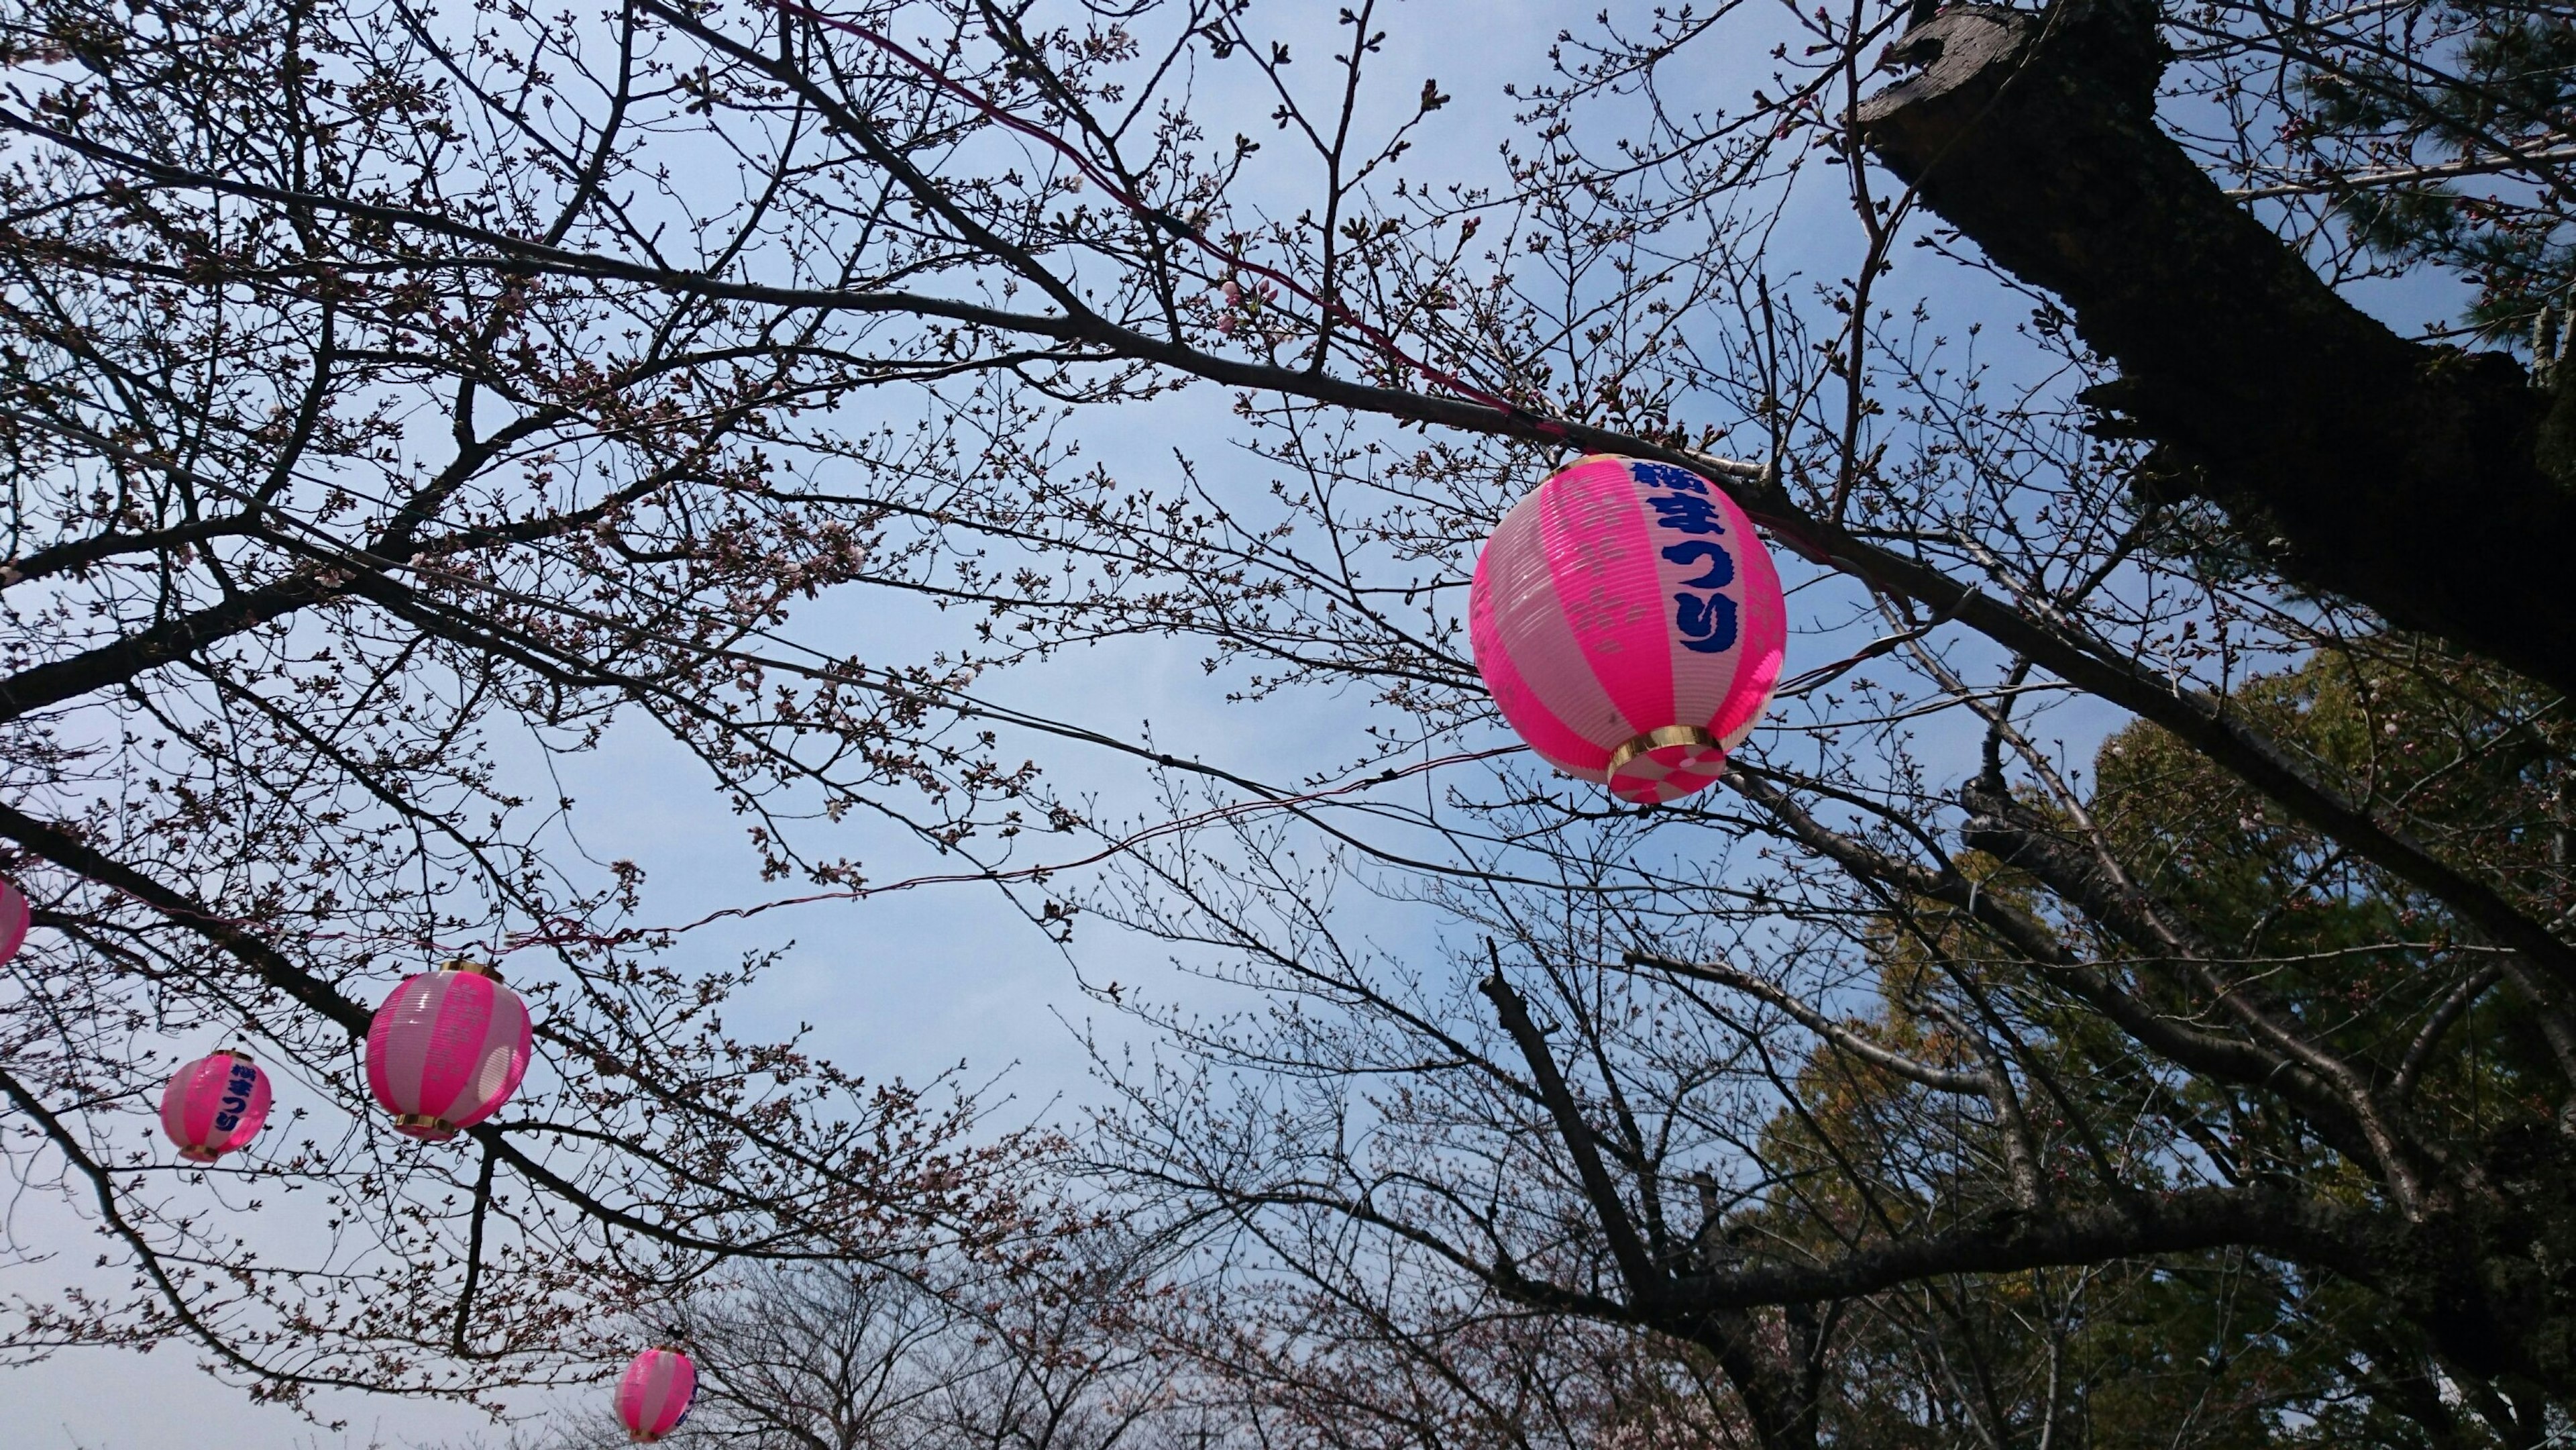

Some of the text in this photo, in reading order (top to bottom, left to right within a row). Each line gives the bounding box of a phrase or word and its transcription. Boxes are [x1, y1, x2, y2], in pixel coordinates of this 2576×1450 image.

[1629, 462, 1737, 653] 桜まつり
[215, 1064, 256, 1131] 桜まつり
